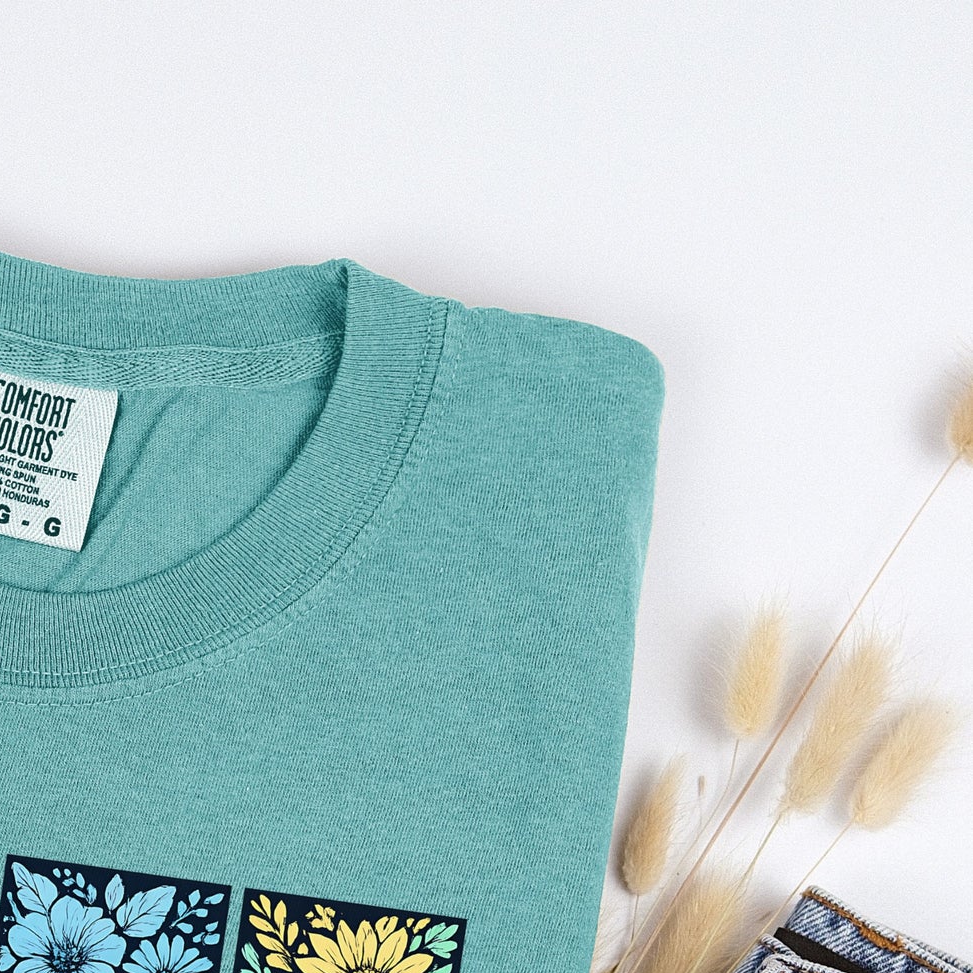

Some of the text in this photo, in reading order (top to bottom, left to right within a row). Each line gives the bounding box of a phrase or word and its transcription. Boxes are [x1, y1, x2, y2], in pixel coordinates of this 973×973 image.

[13, 470, 37, 484] SPUN
[17, 460, 60, 477] GARMENT
[60, 470, 78, 481] DYE
[5, 479, 40, 495] COTTON
[2, 489, 50, 508] HONDURAS
